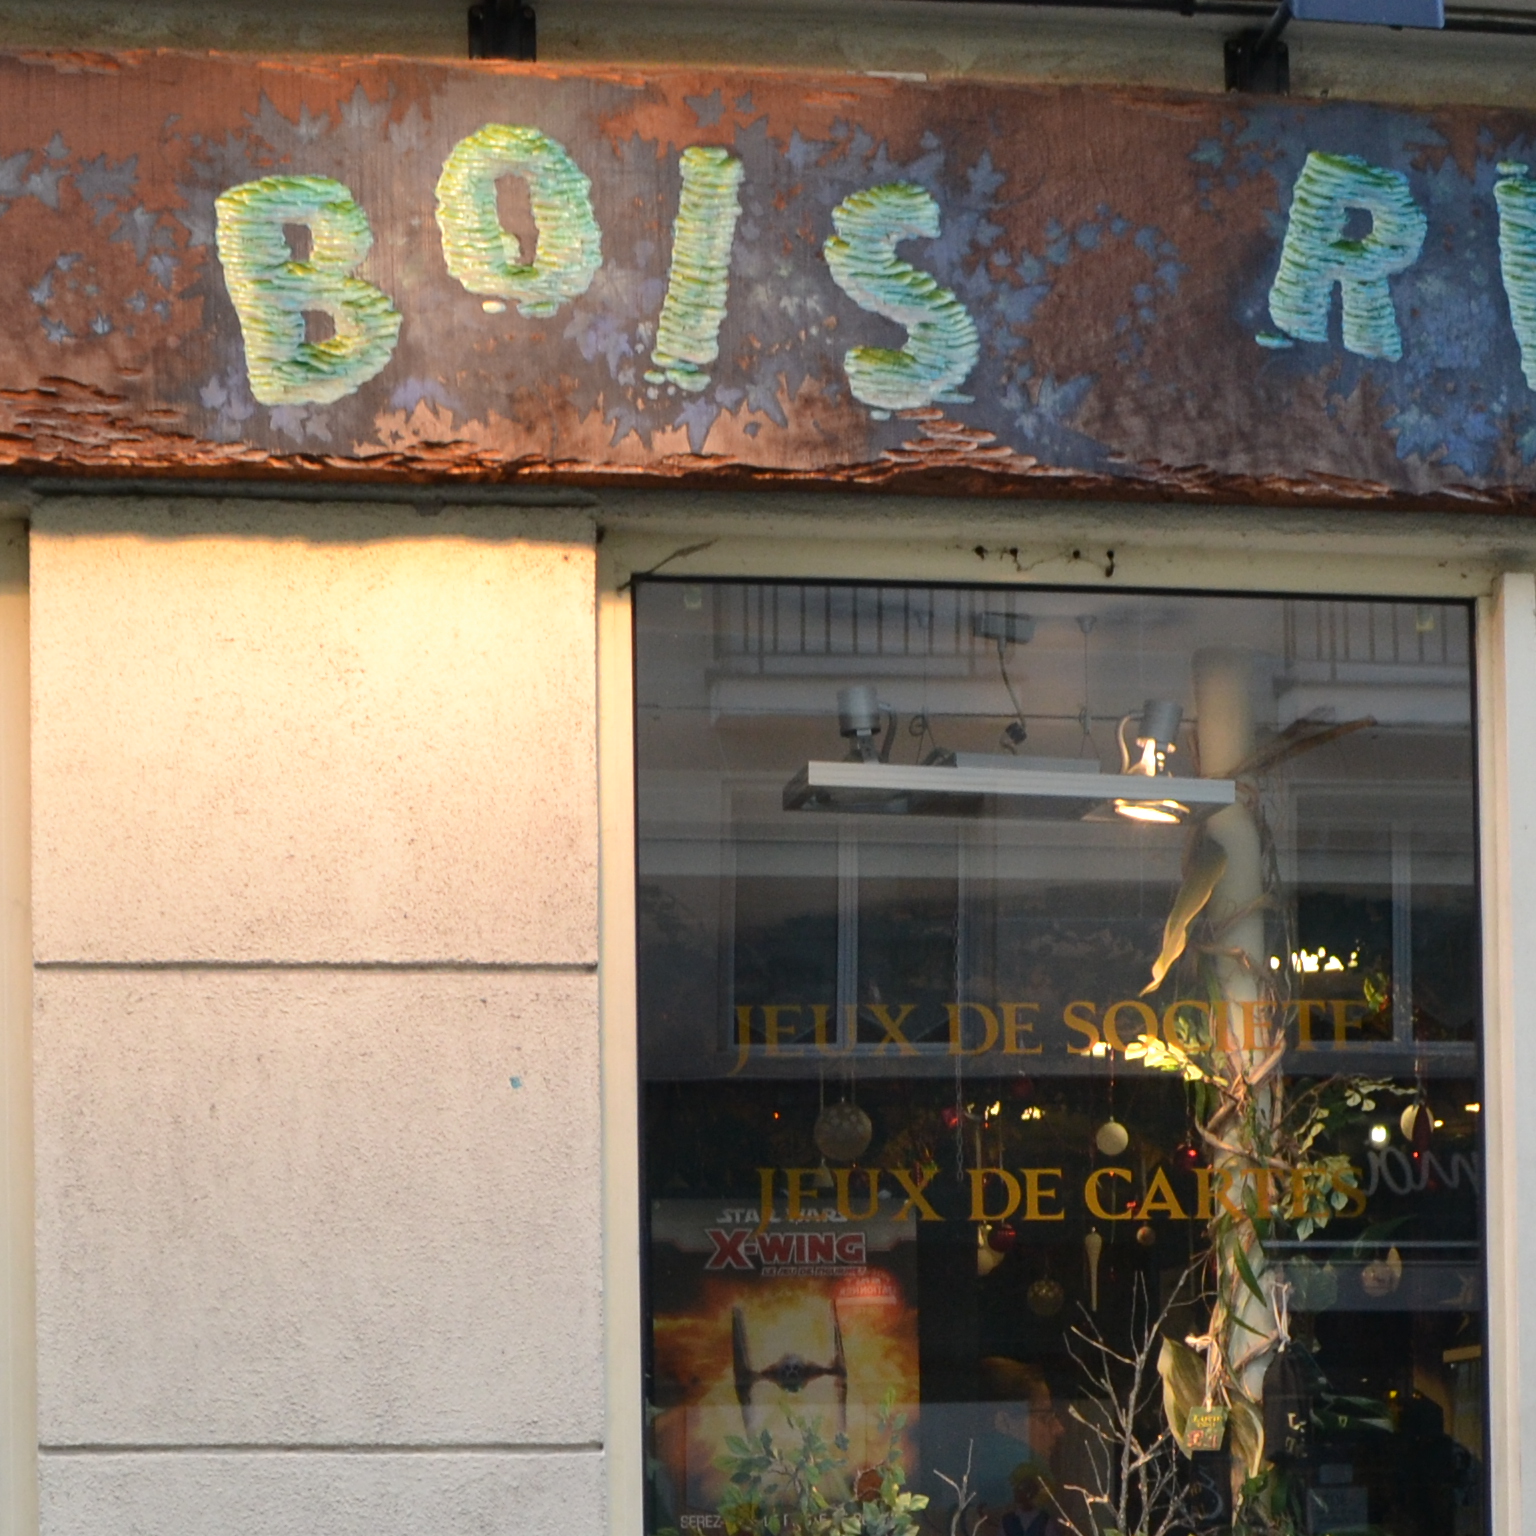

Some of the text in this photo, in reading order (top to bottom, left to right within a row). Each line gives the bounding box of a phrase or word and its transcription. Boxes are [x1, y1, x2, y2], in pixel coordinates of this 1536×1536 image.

[216, 124, 980, 412] BOIS
[730, 1003, 934, 1075] JEUX
[950, 1003, 1043, 1056] DE
[758, 1166, 944, 1235] JEUX
[969, 1166, 1061, 1221] DE
[1084, 1166, 1367, 1221] CARTES
[704, 1228, 866, 1270] X-WING
